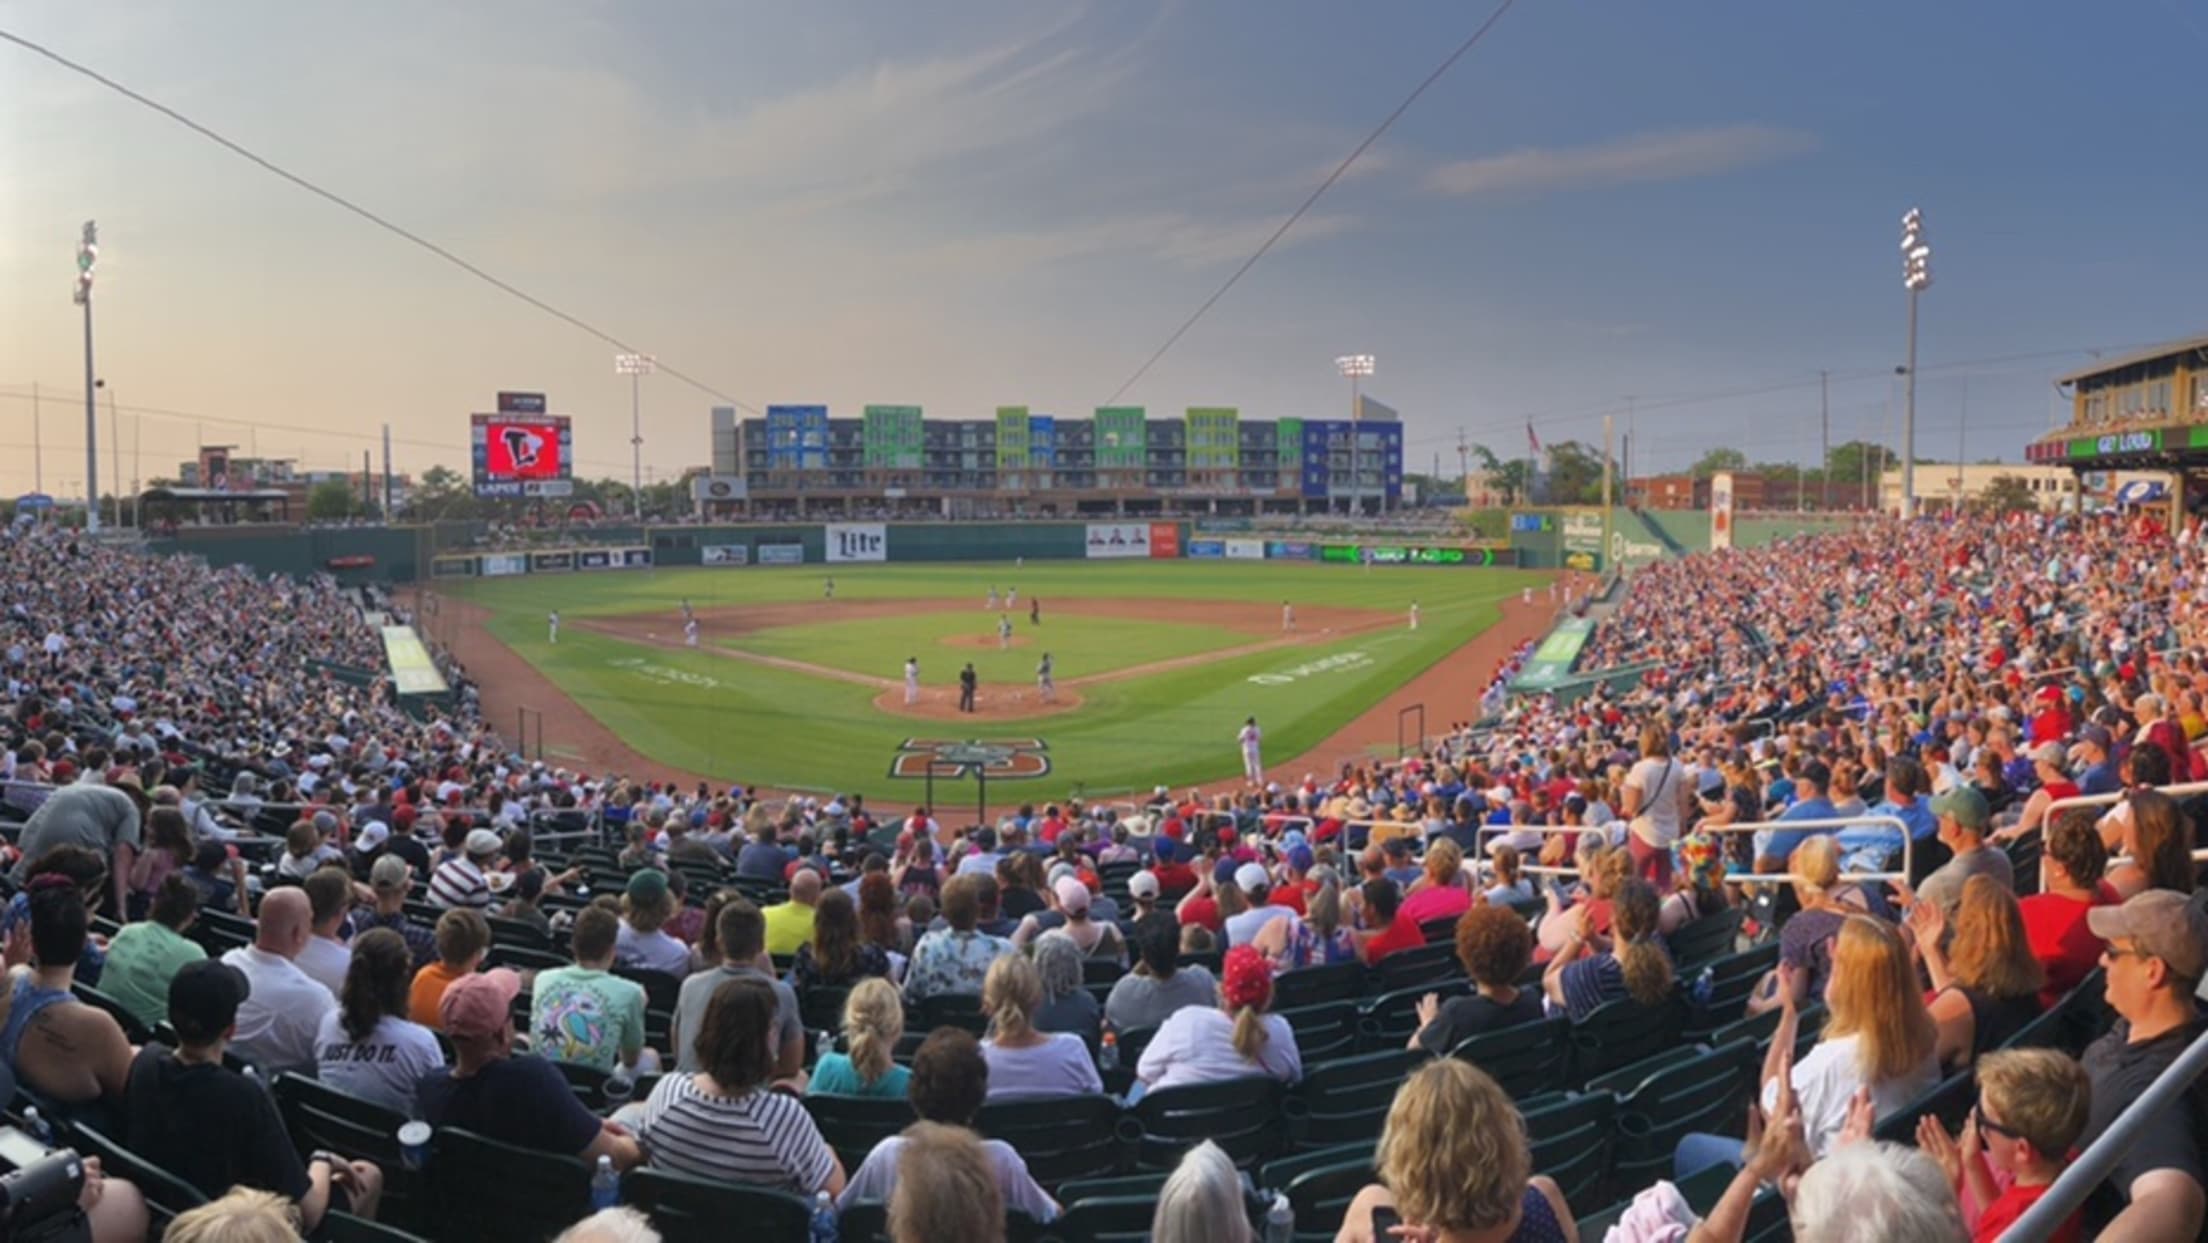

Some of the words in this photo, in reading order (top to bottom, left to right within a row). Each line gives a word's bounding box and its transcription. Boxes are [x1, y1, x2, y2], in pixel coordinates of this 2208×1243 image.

[2119, 431, 2153, 452] LOUD
[840, 532, 881, 558] Lite
[323, 1044, 353, 1062] JUST
[353, 1044, 376, 1062] DO
